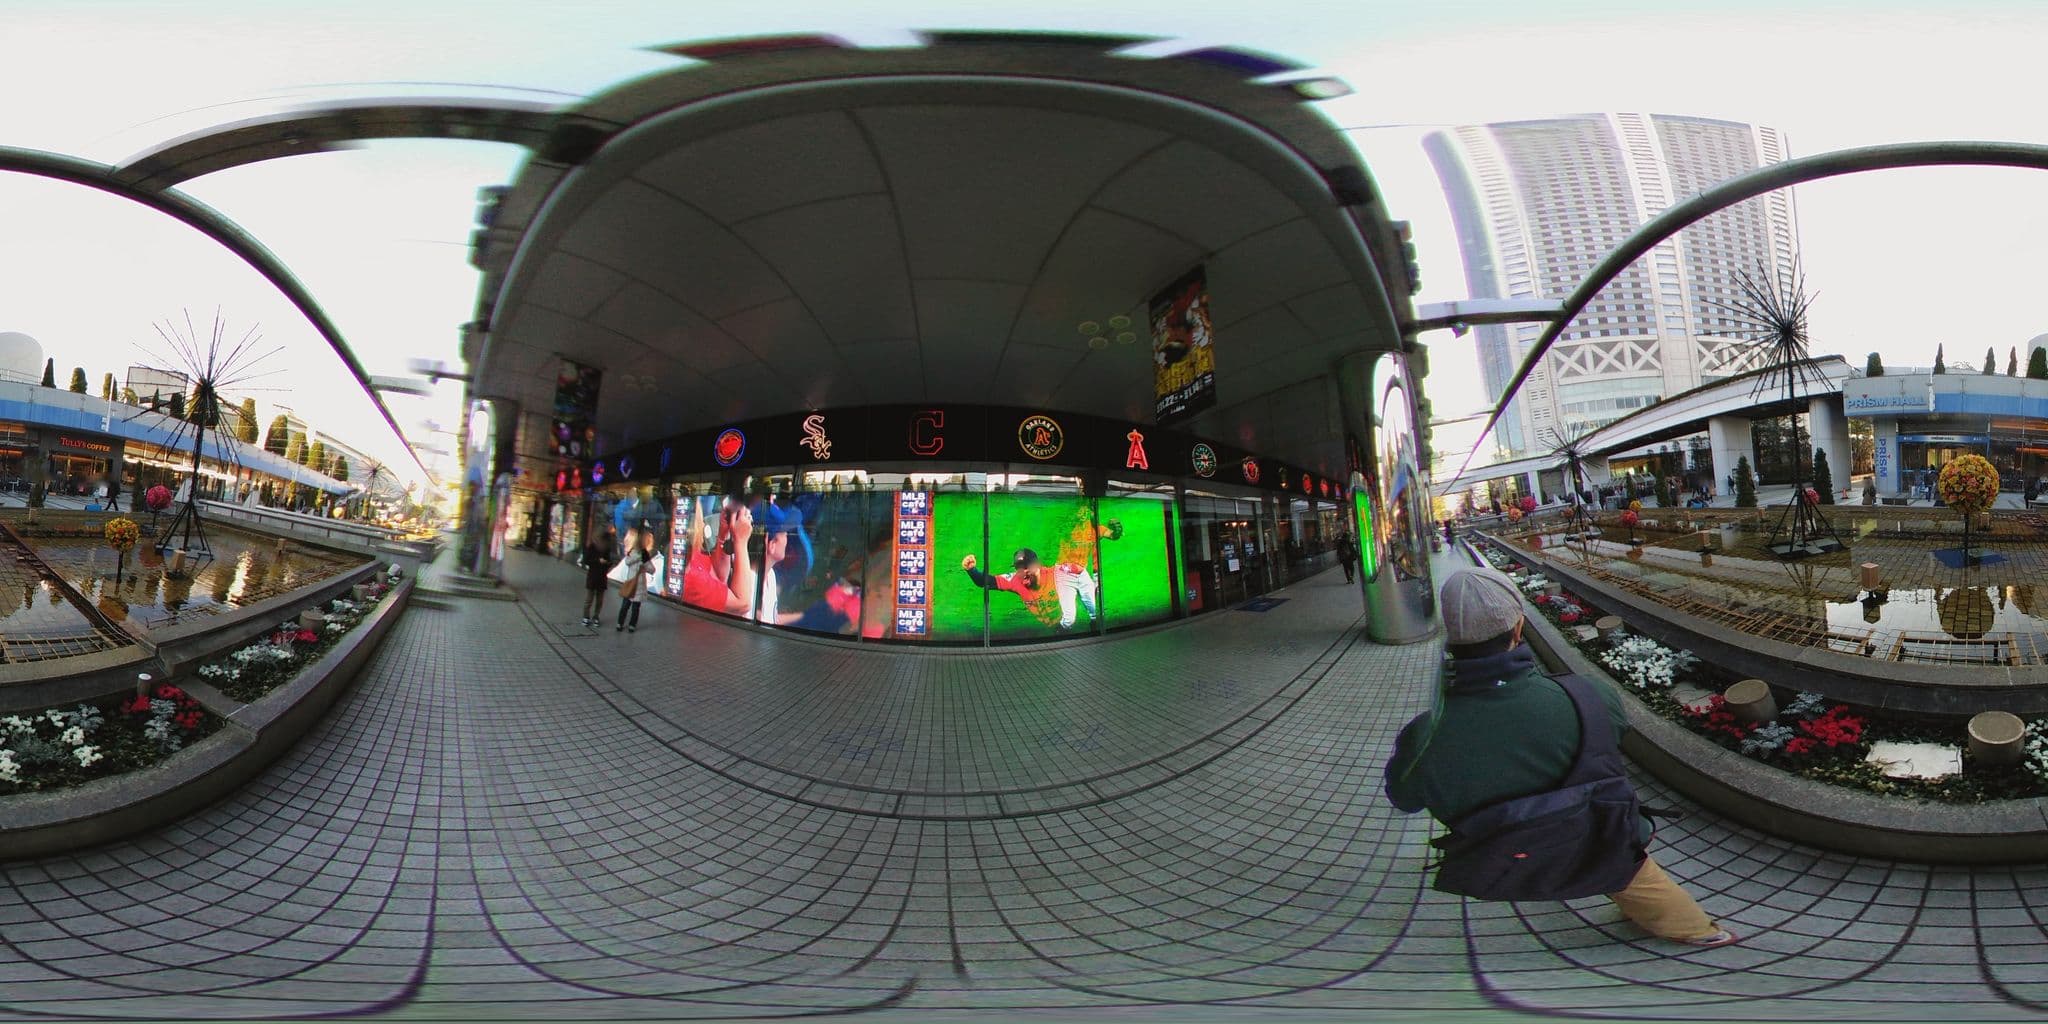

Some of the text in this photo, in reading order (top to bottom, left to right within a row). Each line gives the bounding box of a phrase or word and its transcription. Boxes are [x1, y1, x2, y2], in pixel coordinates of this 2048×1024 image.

[86, 443, 111, 452] COFFEE
[902, 492, 926, 501] MLB
[900, 521, 925, 530] MLB
[900, 551, 925, 560] MLB
[900, 580, 924, 589] MLB
[899, 610, 924, 619] MLB
